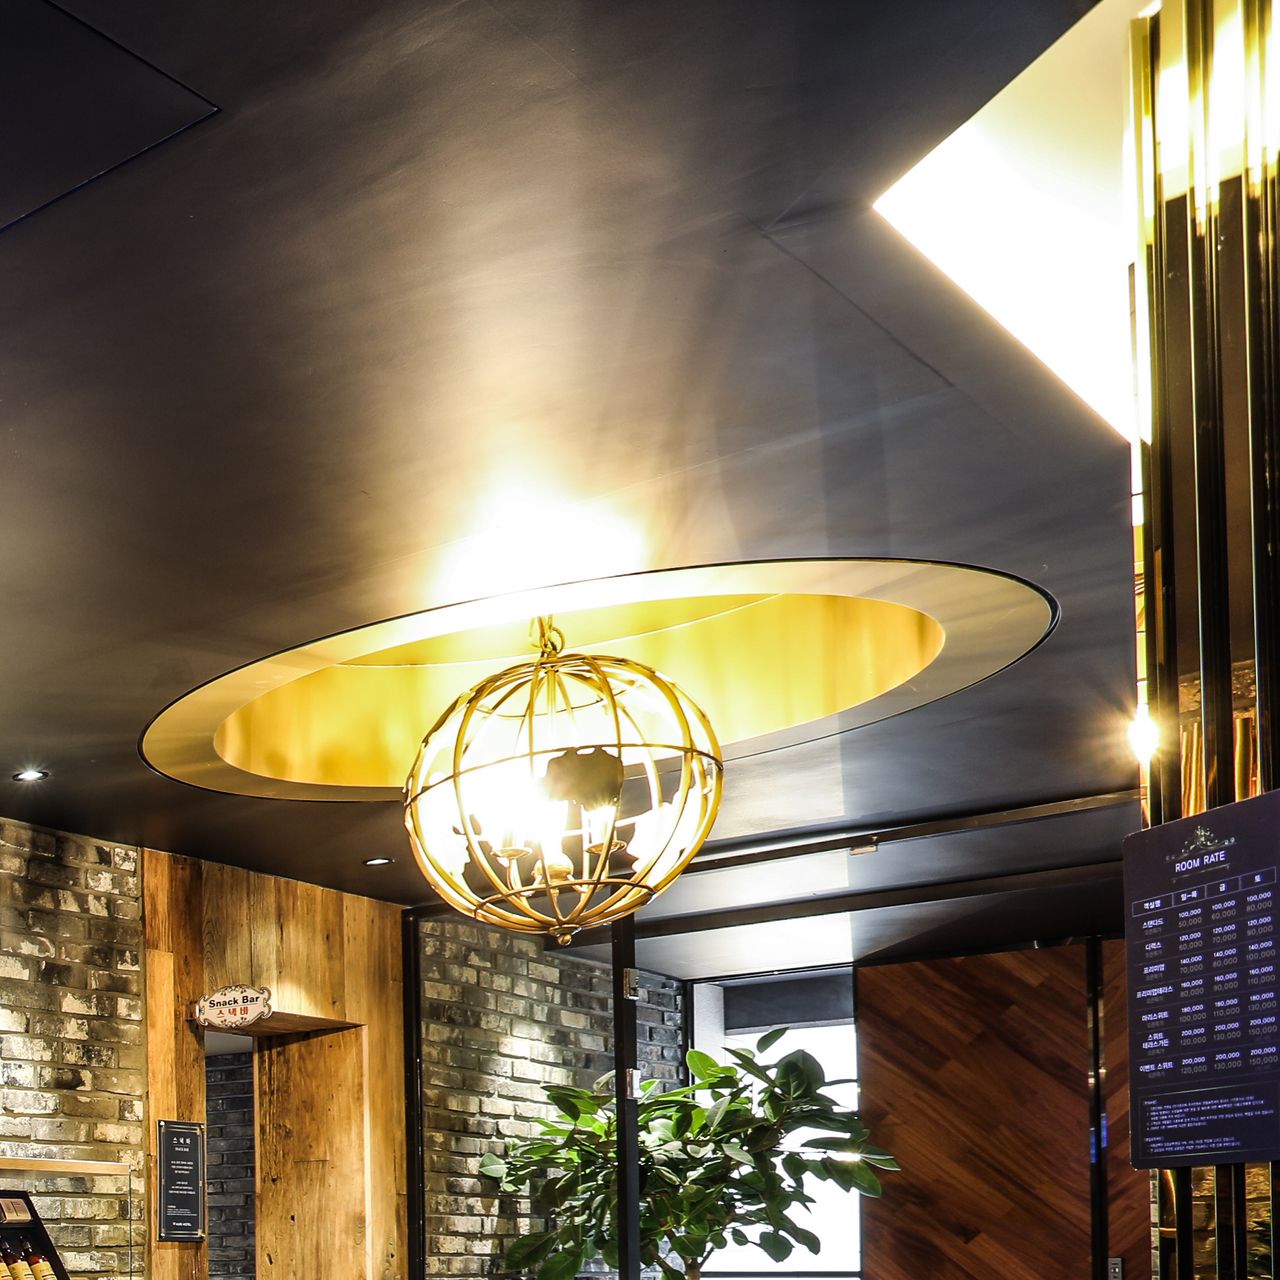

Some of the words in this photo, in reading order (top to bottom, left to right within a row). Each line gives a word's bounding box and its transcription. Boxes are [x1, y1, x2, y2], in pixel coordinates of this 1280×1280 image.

[1175, 858, 1200, 873] ROOM
[1204, 851, 1226, 865] RATE
[209, 997, 239, 1008] Snack
[242, 996, 260, 1004] Bar
